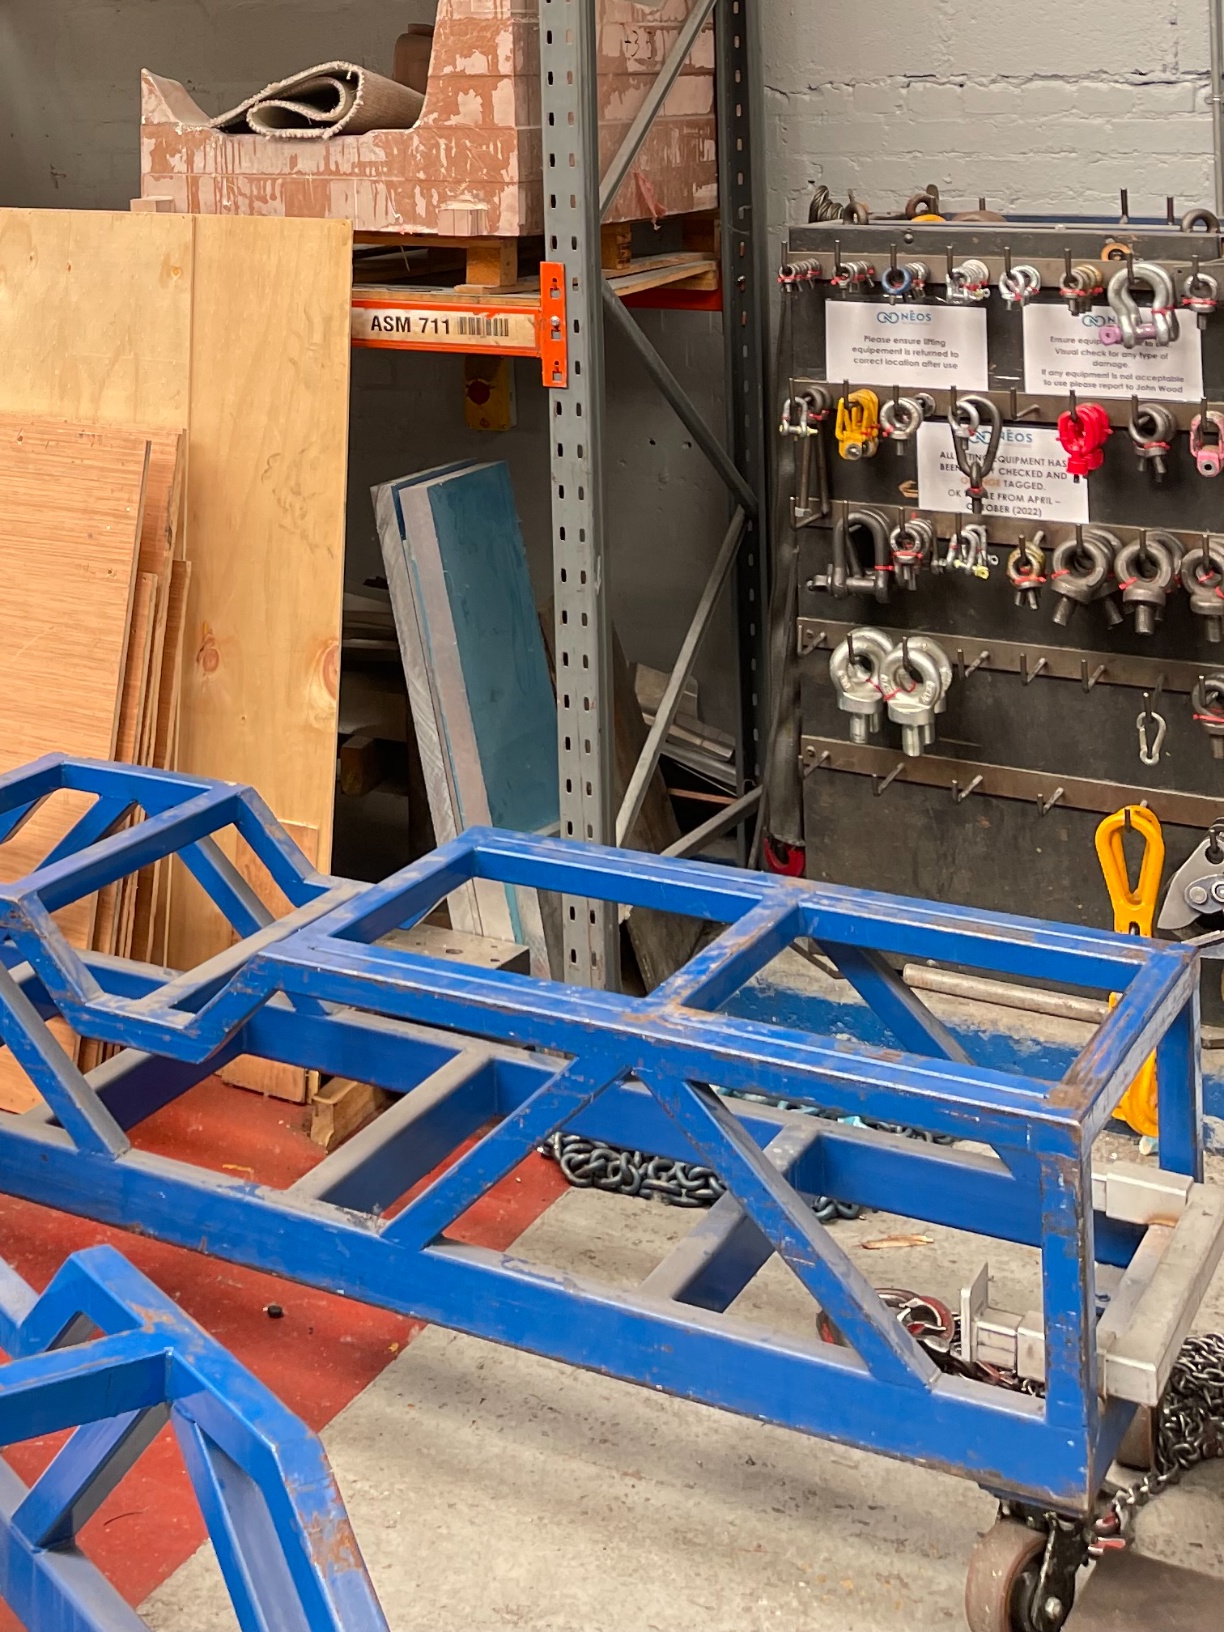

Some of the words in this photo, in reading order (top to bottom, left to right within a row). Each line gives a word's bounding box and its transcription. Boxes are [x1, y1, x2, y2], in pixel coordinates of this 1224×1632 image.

[371, 315, 411, 333] ASM
[419, 317, 450, 335] 711
[864, 335, 891, 344] Please
[924, 338, 946, 347] lifting
[1050, 336, 1076, 344] Ensure
[913, 349, 948, 358] returned
[1081, 349, 1107, 357] check
[1108, 350, 1119, 358] for
[1122, 352, 1137, 360] any
[1139, 352, 1158, 361] type
[853, 357, 883, 365] correct
[885, 358, 920, 367] location
[922, 360, 941, 368] after
[1092, 360, 1130, 369] damage.
[1048, 370, 1063, 378] any
[1065, 370, 1110, 380] equipment
[1135, 374, 1184, 383] acceptable
[1069, 380, 1097, 389] please
[1098, 382, 1124, 391] report
[1137, 384, 1156, 392] John
[1158, 385, 1183, 393] Wood
[940, 452, 954, 460] ALL
[1049, 459, 1067, 468] HAS
[999, 468, 1043, 478] CHECKED
[1046, 471, 1067, 480] AND
[1003, 481, 1046, 491] TAGGED.
[948, 490, 962, 498] OK
[997, 494, 1025, 503] FROM
[1027, 496, 1053, 505] APRIL
[1013, 506, 1042, 517] (2022)
